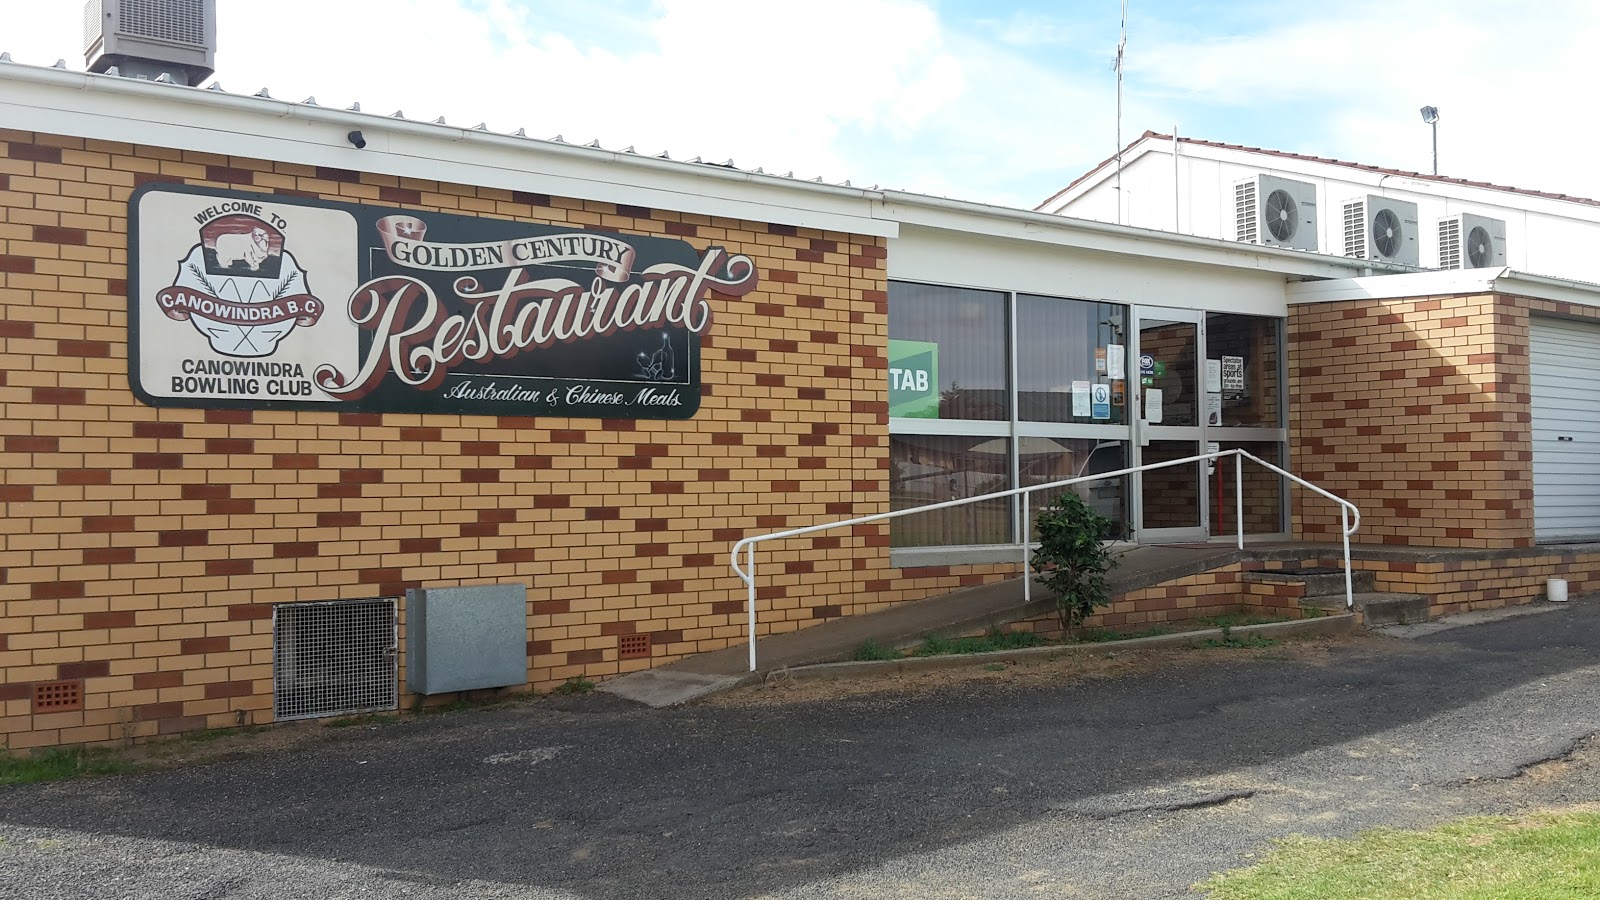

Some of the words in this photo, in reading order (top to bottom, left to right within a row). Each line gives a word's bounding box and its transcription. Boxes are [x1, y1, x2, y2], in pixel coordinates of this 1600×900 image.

[193, 201, 263, 226] WELCOME
[391, 240, 503, 268] GOLDEN
[511, 236, 629, 265] CENTURY
[161, 293, 285, 321] CANOWINDRA
[313, 246, 756, 396] Restaurant
[181, 359, 304, 378] CANOWINDRA
[889, 368, 929, 392] TAB
[1223, 370, 1243, 379] sports
[171, 376, 260, 395] BOWLING
[266, 379, 313, 396] CLUB
[443, 380, 541, 402] Australian
[545, 388, 560, 407] &
[565, 384, 624, 405] Chinese
